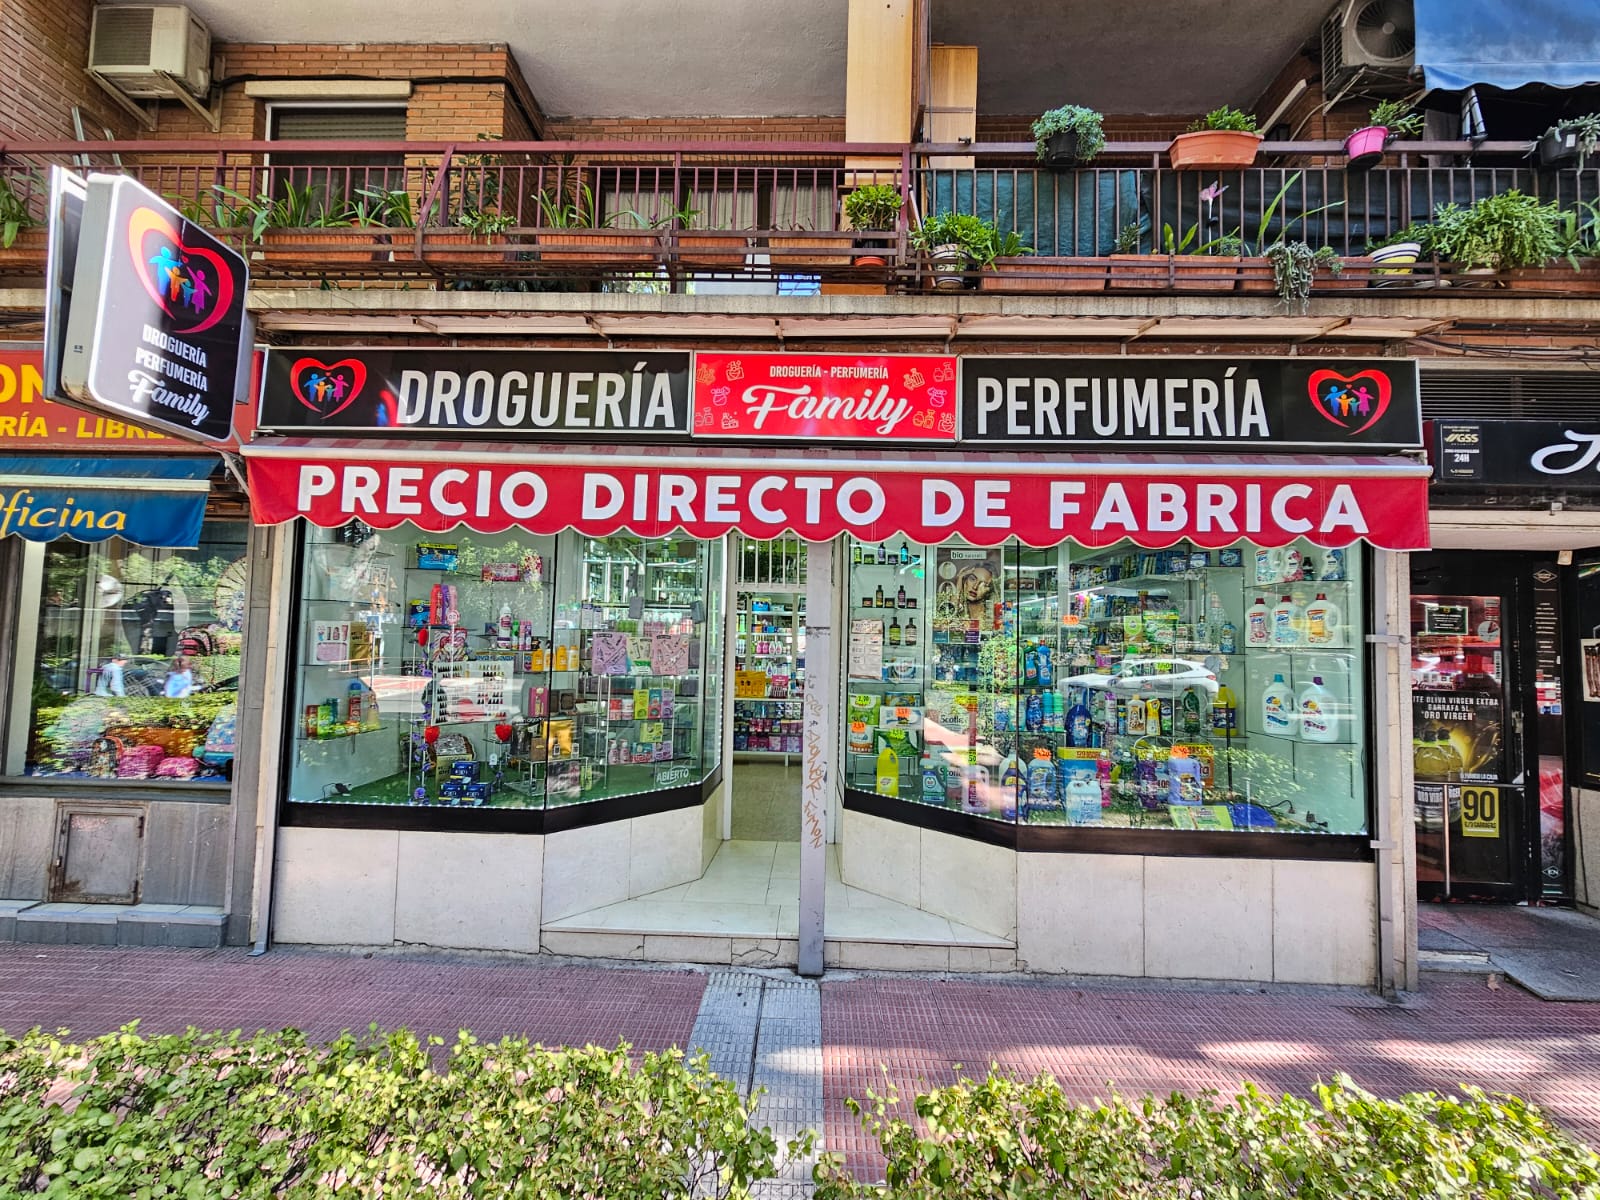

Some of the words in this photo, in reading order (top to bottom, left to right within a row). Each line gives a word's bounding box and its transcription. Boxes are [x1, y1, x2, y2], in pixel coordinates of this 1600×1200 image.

[142, 323, 207, 368] DROGUERÍA
[135, 346, 208, 392] PERFUMERÍA
[769, 364, 821, 379] DROGUERÍA
[830, 364, 889, 380] PERFUMERÍA
[128, 370, 210, 426] Family
[396, 361, 676, 428] DROGUERÍA
[742, 384, 913, 435] Family
[976, 366, 1271, 438] PERFUMERÍA
[297, 465, 549, 520] PRECIO
[582, 473, 886, 526] DIRECTO
[921, 478, 1011, 529] DE
[1049, 481, 1370, 534] FABRICA
[1426, 696, 1446, 704] OLIVA
[1448, 697, 1474, 705] VIRGEN
[1476, 698, 1499, 706] EXTRA
[656, 768, 689, 783] ABIERTO
[1463, 790, 1495, 822] 90
